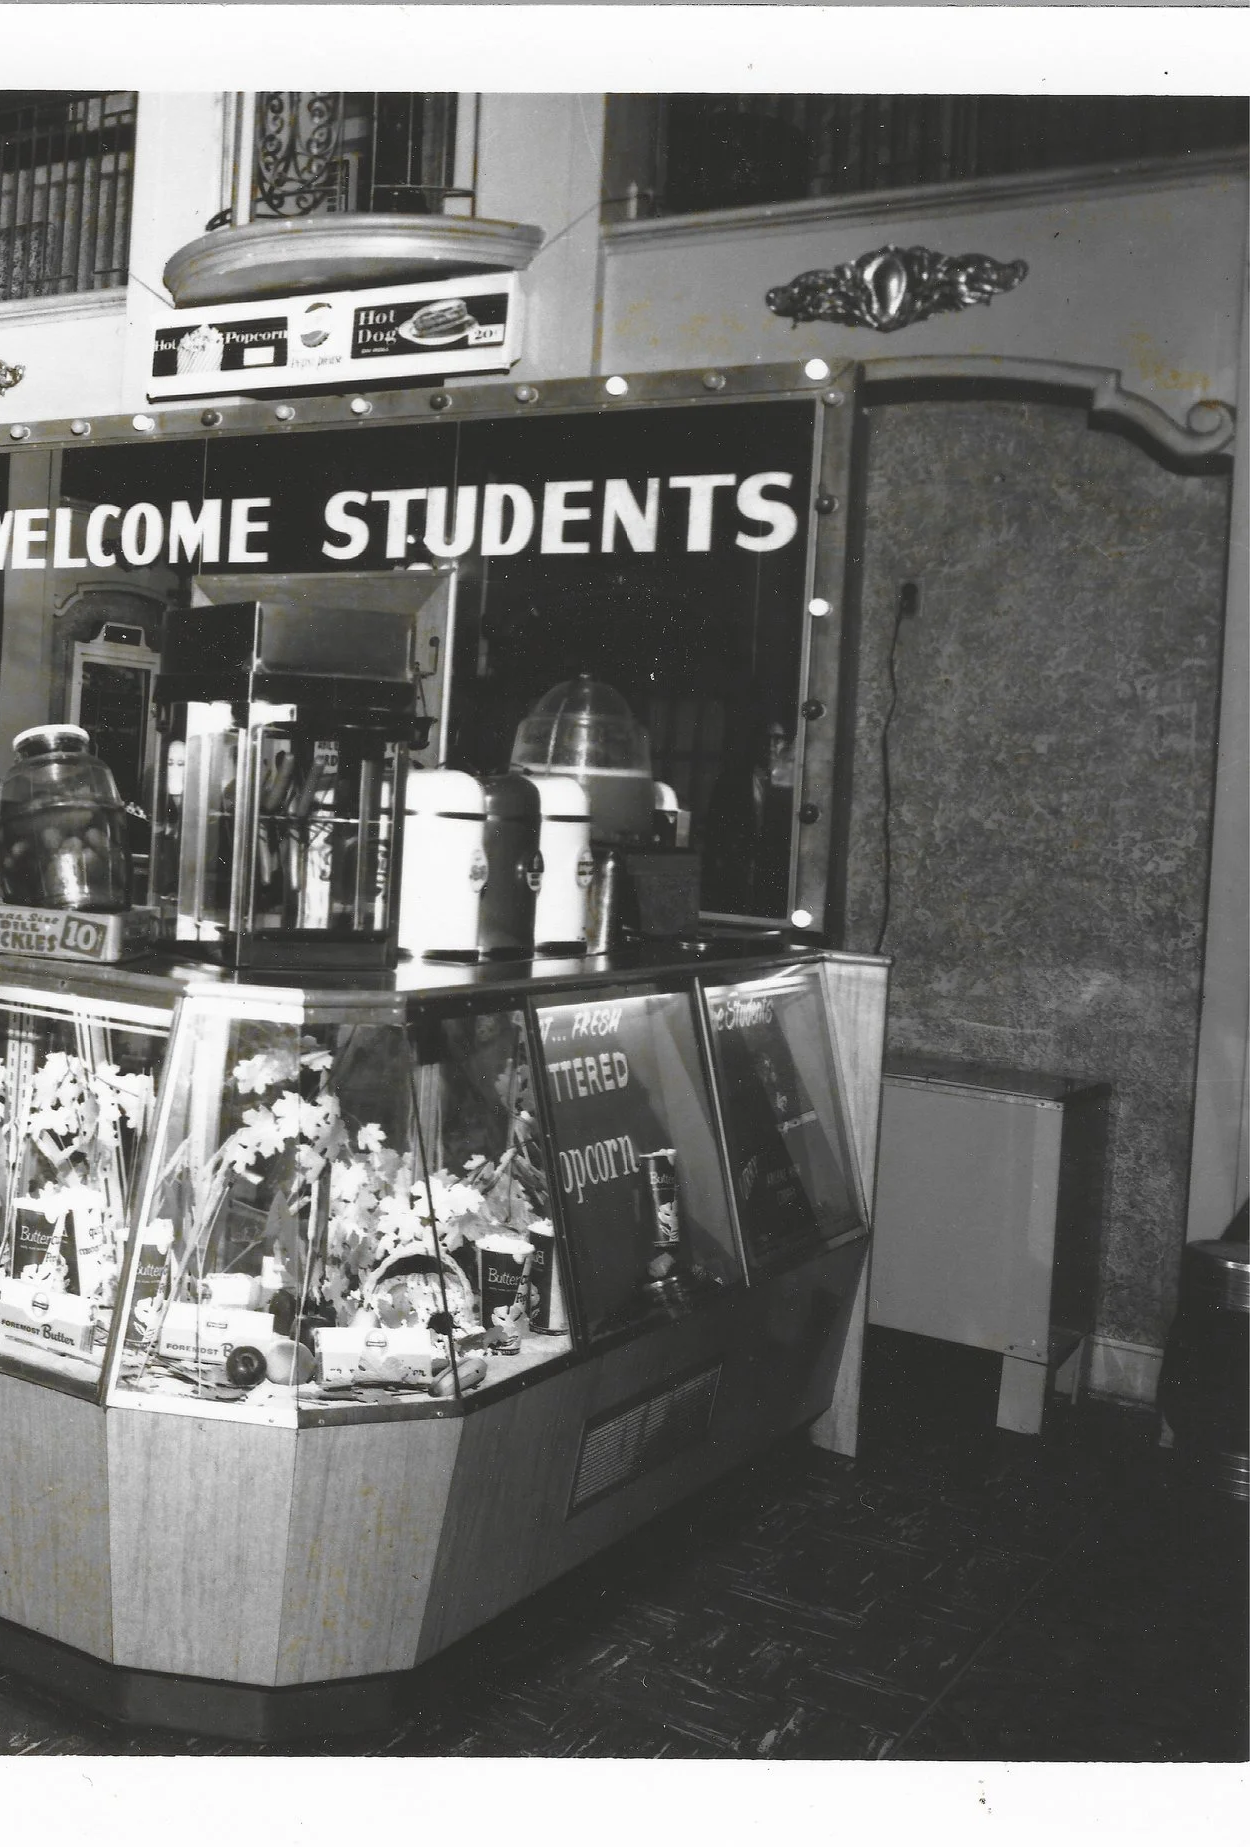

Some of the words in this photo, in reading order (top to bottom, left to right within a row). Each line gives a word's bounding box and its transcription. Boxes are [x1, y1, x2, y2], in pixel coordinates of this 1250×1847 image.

[358, 309, 395, 326] Hot
[154, 340, 177, 351] Hot
[225, 328, 288, 345] Popcorn
[357, 327, 399, 345] Dog
[322, 471, 799, 561] STUDENTS
[571, 1007, 623, 1040] FRESH
[1, 1319, 41, 1336] FOREMOST
[41, 1323, 76, 1347] Butter
